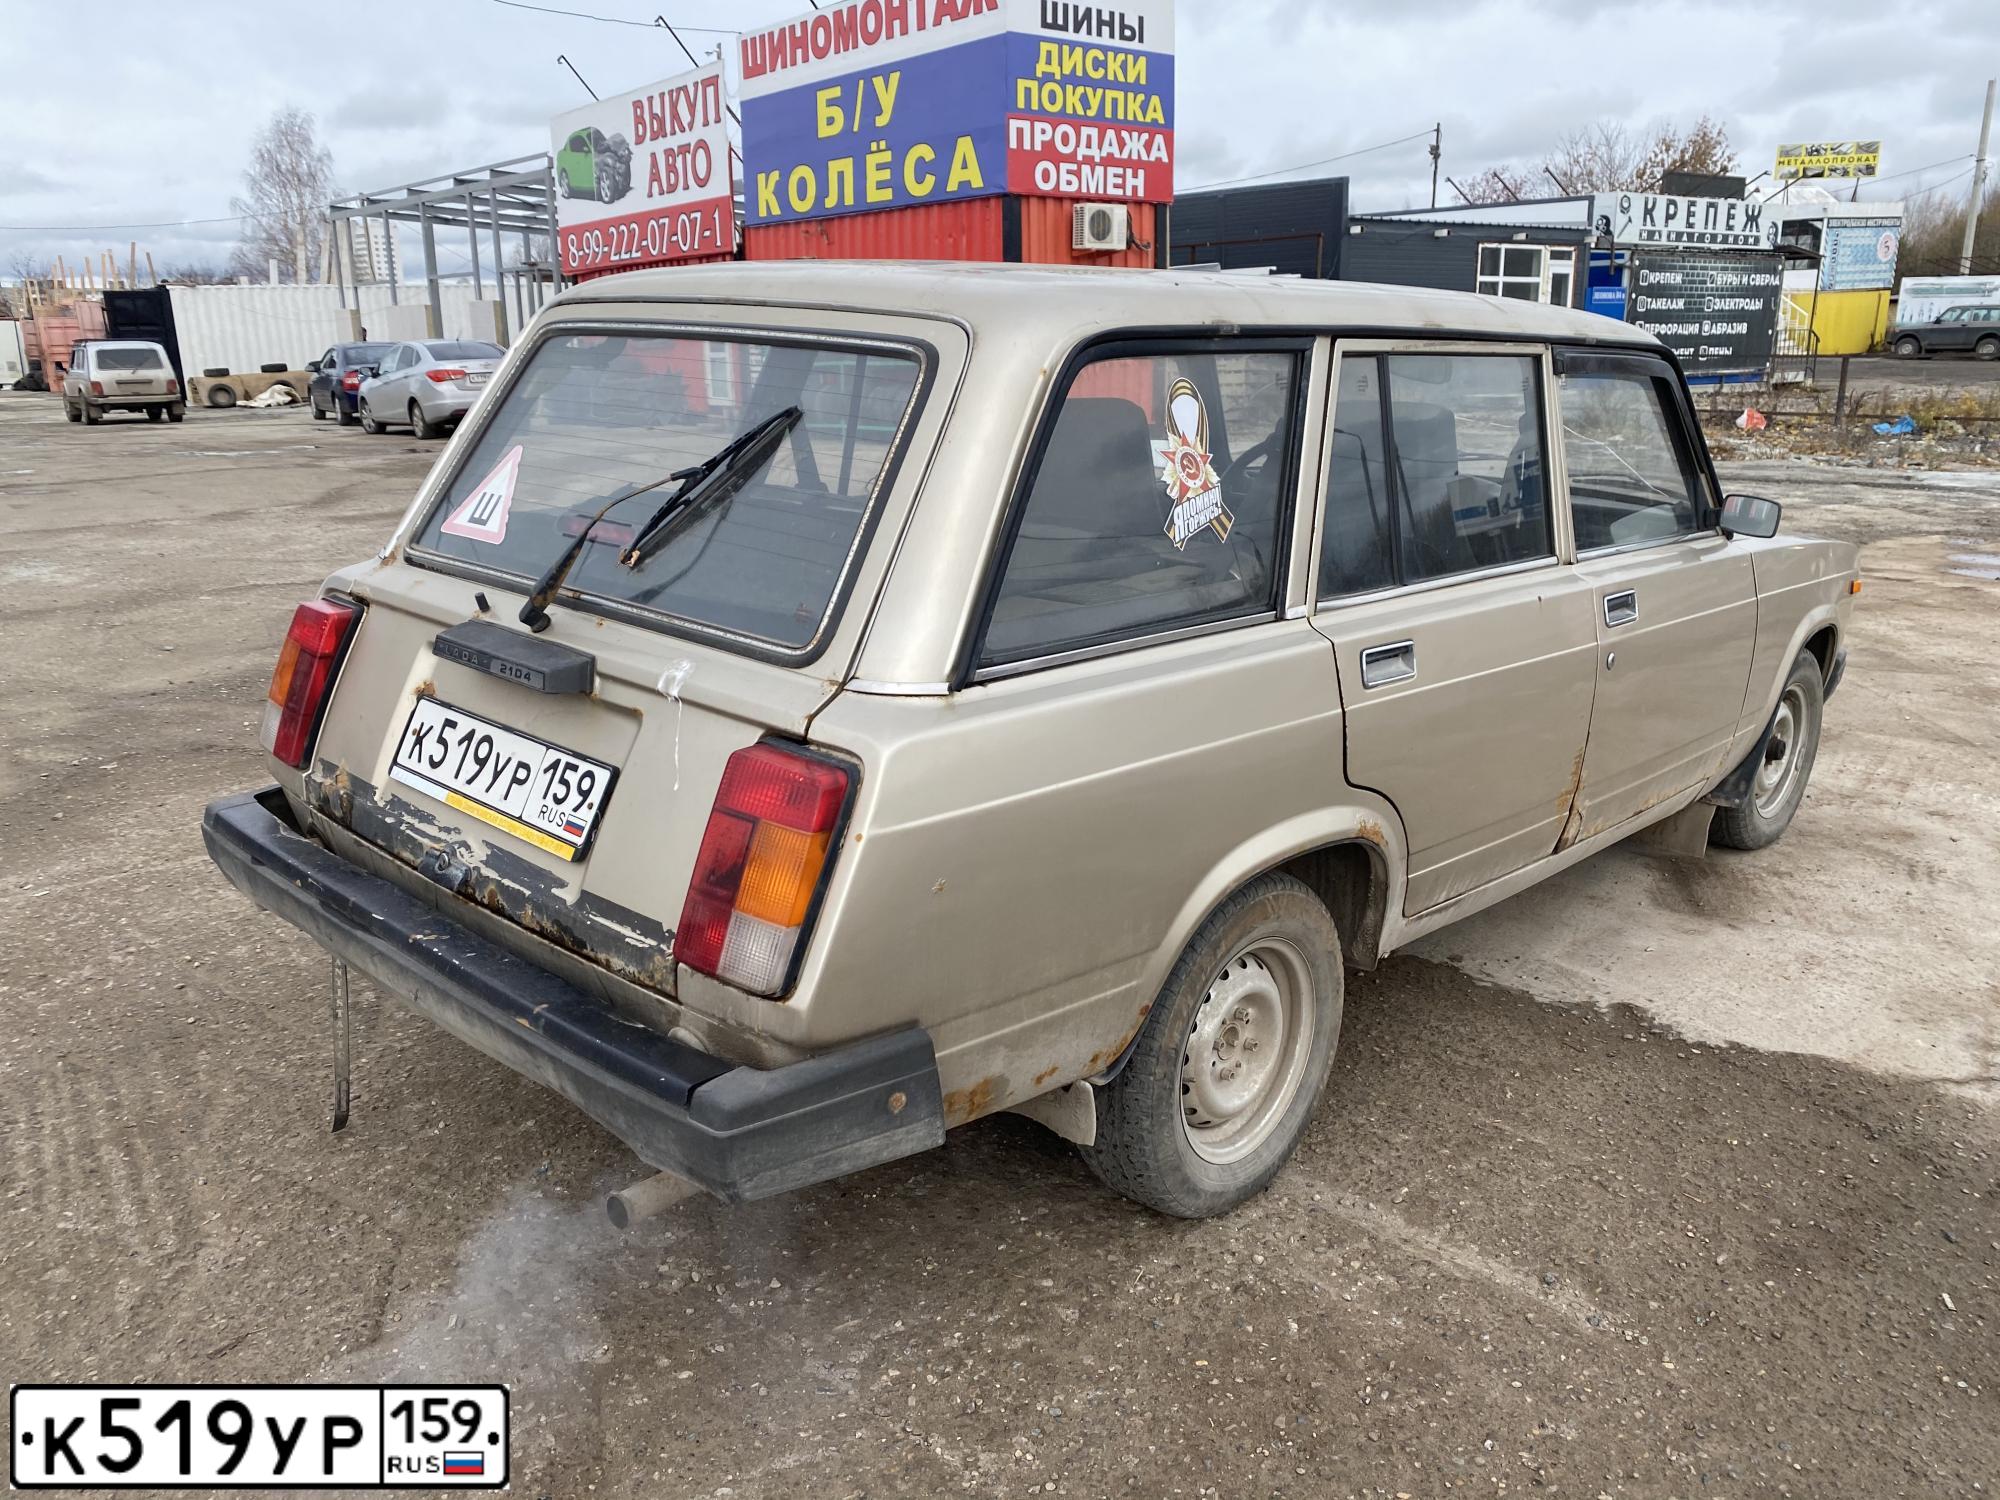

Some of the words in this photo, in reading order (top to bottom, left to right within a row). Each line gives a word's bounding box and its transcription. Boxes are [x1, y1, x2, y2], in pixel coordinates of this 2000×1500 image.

[741, 0, 998, 80] ШИНОМОНТА
[1040, 0, 1144, 44] ШИНЫ
[1035, 40, 1147, 86] ДИСКИ
[632, 74, 722, 145] ВЫКУП
[816, 70, 901, 139] Б/У
[1016, 78, 1165, 125] ПОКУПКА
[1008, 118, 1169, 163] ПРОДАЖА
[647, 138, 712, 198] АВТО
[756, 135, 985, 218] КОЛЁСА
[1034, 160, 1146, 197] ОБМЕН
[1777, 155, 1877, 166] МЕТАЛЛОПРОКАТ
[1642, 195, 1763, 233] КРЕПЕЖ
[567, 205, 722, 268] 8-99-222-07-07-1
[1640, 230, 1660, 241] НА
[1668, 231, 1756, 246] НАГОРНОМ
[1649, 271, 1682, 284] КРЕПЕЖ
[1717, 272, 1741, 285] БУРЫ
[1741, 273, 1748, 285] И
[1749, 274, 1780, 286] СВЕРЛА
[1646, 297, 1684, 310] ТАКЕЛАЖ
[1714, 298, 1763, 310] ЭЛЕКТРОДЫ
[1644, 322, 1700, 335] ПЕРФОРАЦИЯ
[1711, 322, 1748, 335] АБРАЗИВ
[467, 491, 502, 526] Ш
[499, 663, 532, 682] 2104
[407, 717, 532, 801] К519УР
[543, 758, 596, 813] 159
[537, 804, 567, 828] RUS
